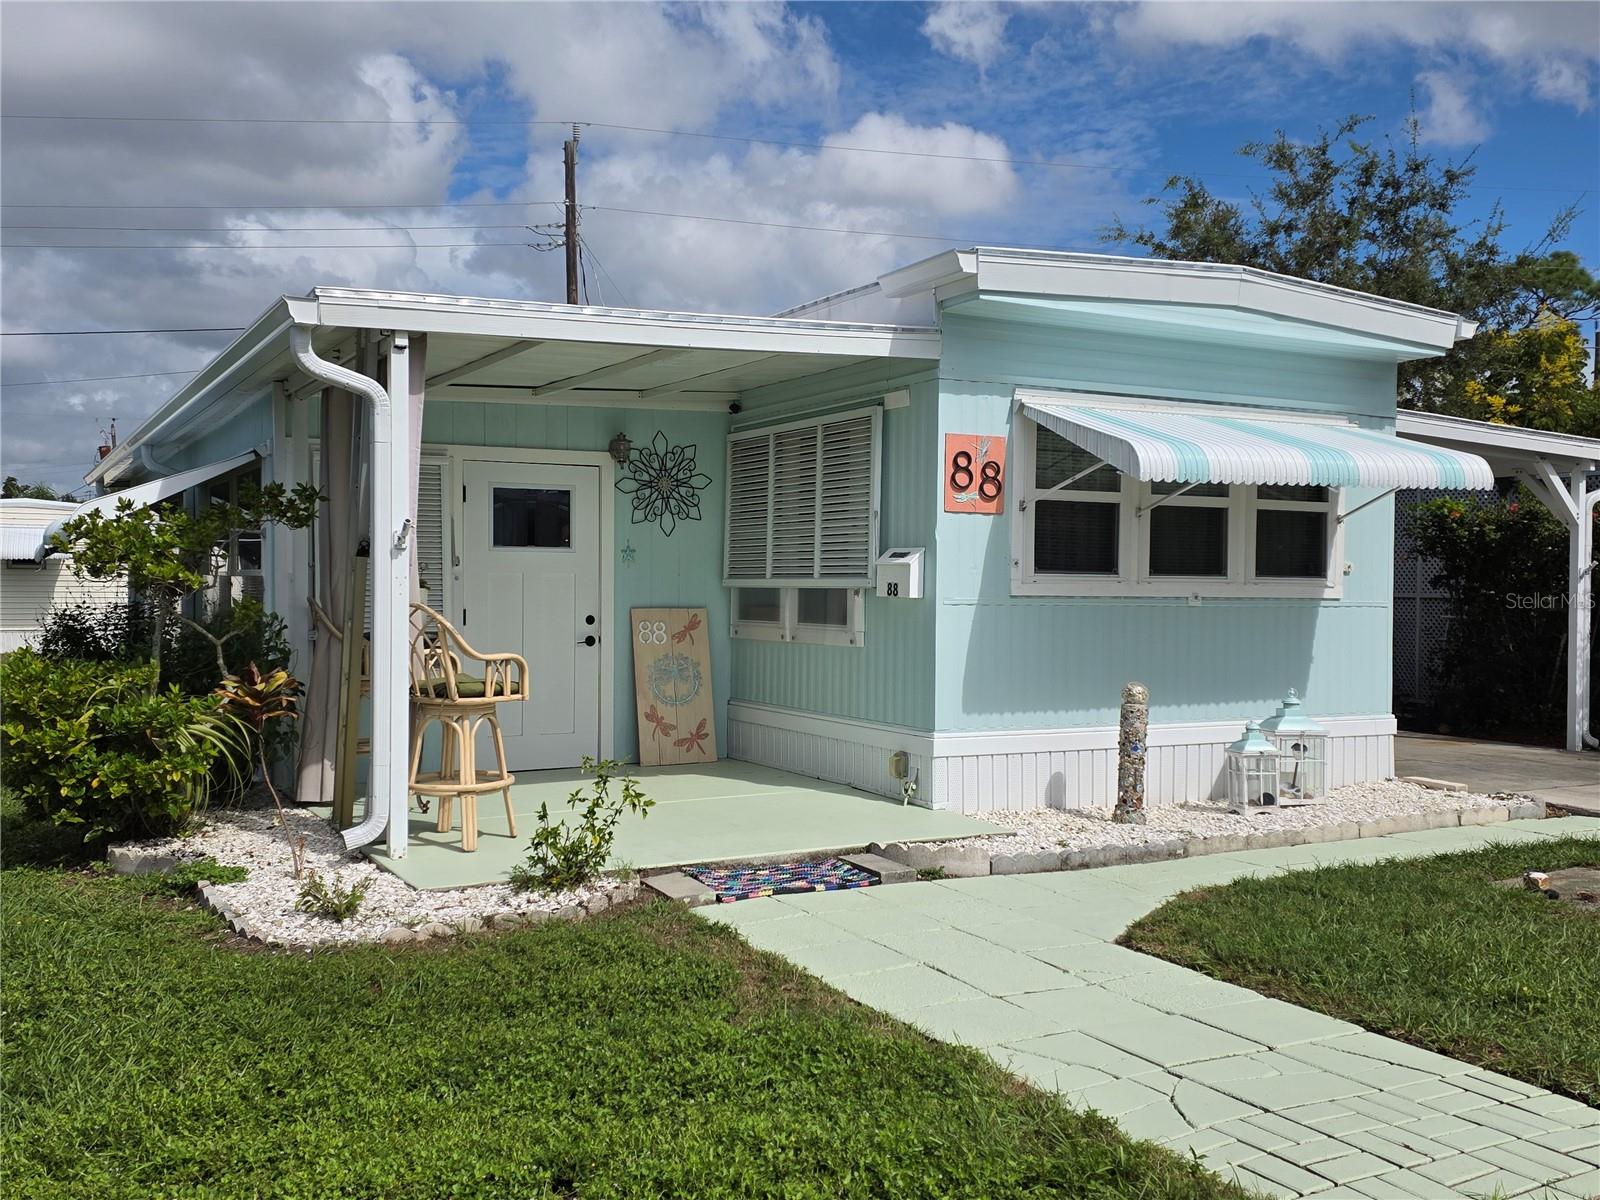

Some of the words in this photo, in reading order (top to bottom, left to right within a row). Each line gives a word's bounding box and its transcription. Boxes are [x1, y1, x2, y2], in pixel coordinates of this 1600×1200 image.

[950, 450, 1002, 502] 88
[887, 582, 899, 597] 88
[638, 621, 667, 645] 88
